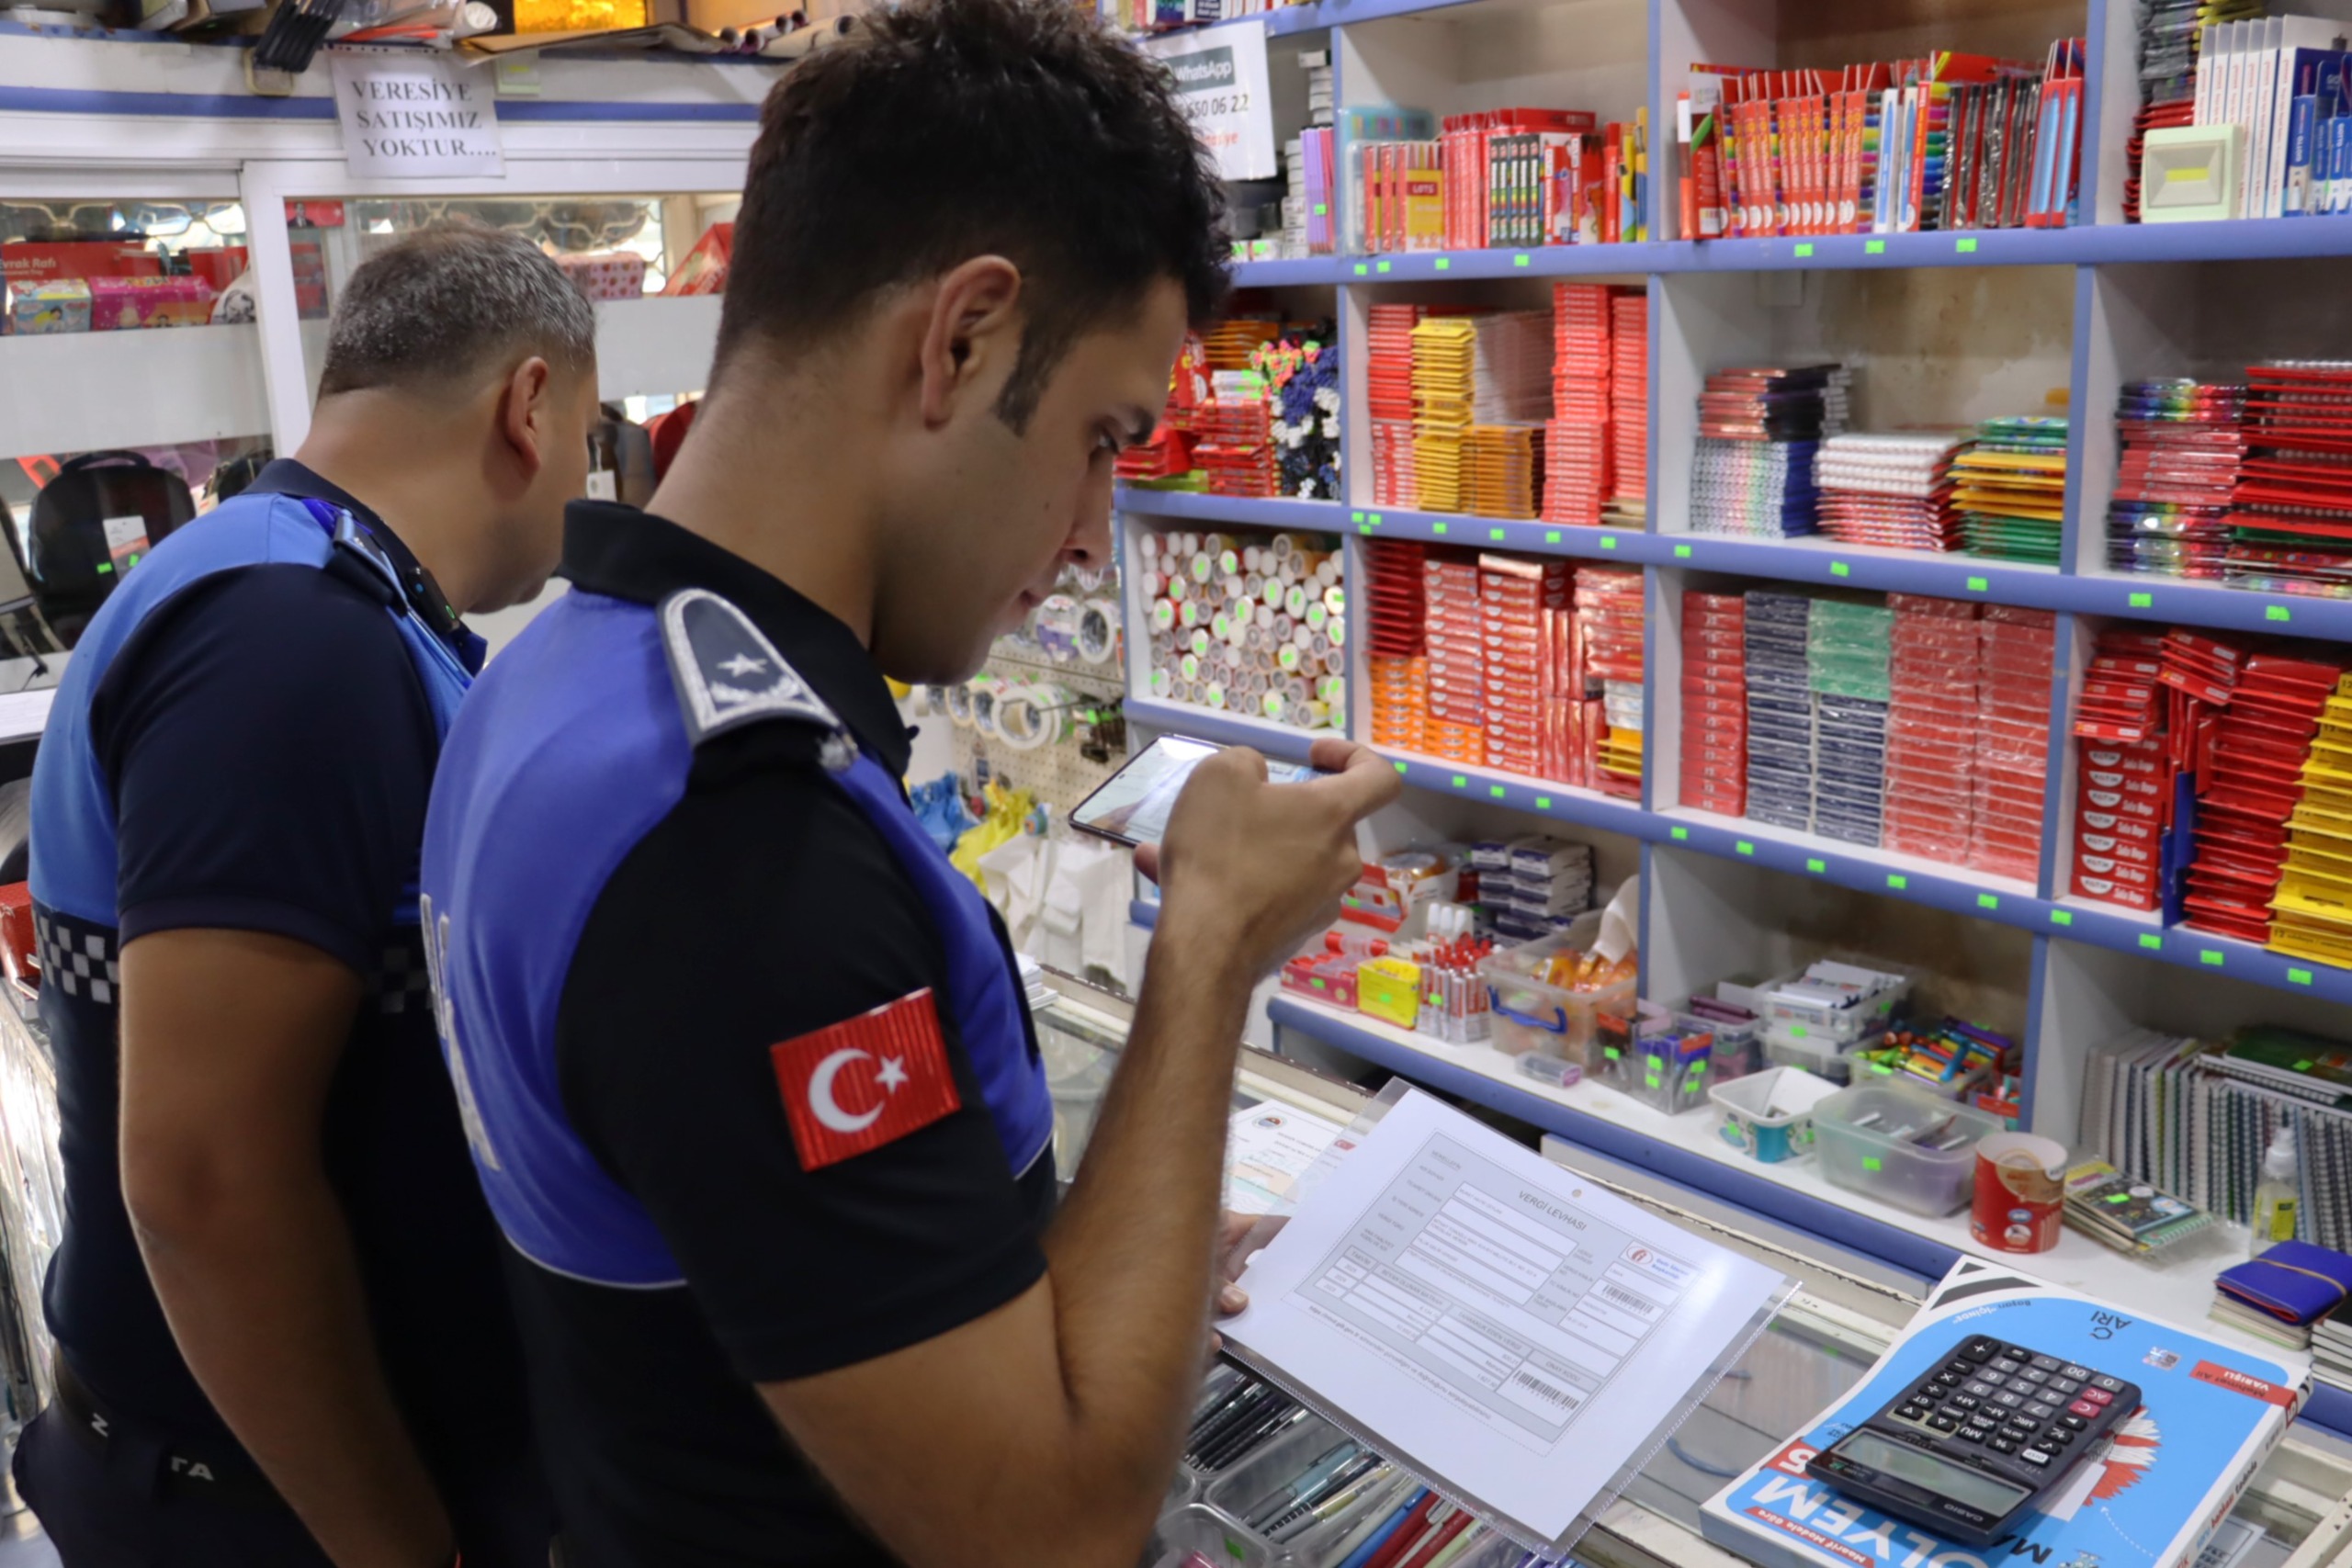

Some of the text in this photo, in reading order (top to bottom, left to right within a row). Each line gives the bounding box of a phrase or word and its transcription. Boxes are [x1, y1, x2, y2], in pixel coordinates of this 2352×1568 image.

[1174, 61, 1232, 81] WhatsApp
[352, 79, 471, 102] VERESİYE
[357, 110, 481, 132] SATIŞIMIZ
[1516, 1189, 1550, 1211] VERGİ
[1544, 1204, 1588, 1231] LEVHASI
[2090, 1311, 2132, 1330] ARI
[1998, 1360, 2010, 1370] 3
[1987, 1371, 1998, 1381] 6
[2028, 1370, 2041, 1379] 2
[2067, 1366, 2086, 1378] 00
[2018, 1381, 2028, 1392] 5
[2103, 1378, 2115, 1387] 0
[2197, 1370, 2266, 1398] Mehmet Ali
[2224, 1371, 2269, 1392] VARIŞLI
[1973, 1384, 1984, 1393] 9
[1913, 1395, 1928, 1405] GT
[2004, 1393, 2015, 1404] 8
[2045, 1392, 2057, 1402] 4
[2086, 1389, 2109, 1401] AC
[2030, 1404, 2044, 1415] 7
[2077, 1403, 2093, 1413] C
[2013, 1416, 2036, 1428] MRC
[1960, 1426, 1983, 1439] MU
[1779, 1449, 1816, 1474] 5
[1758, 1509, 1784, 1526] Göre
[1943, 1502, 1984, 1523] CASIO
[1750, 1475, 1991, 1568] LYEM
[1824, 1538, 1867, 1564] Maarif
